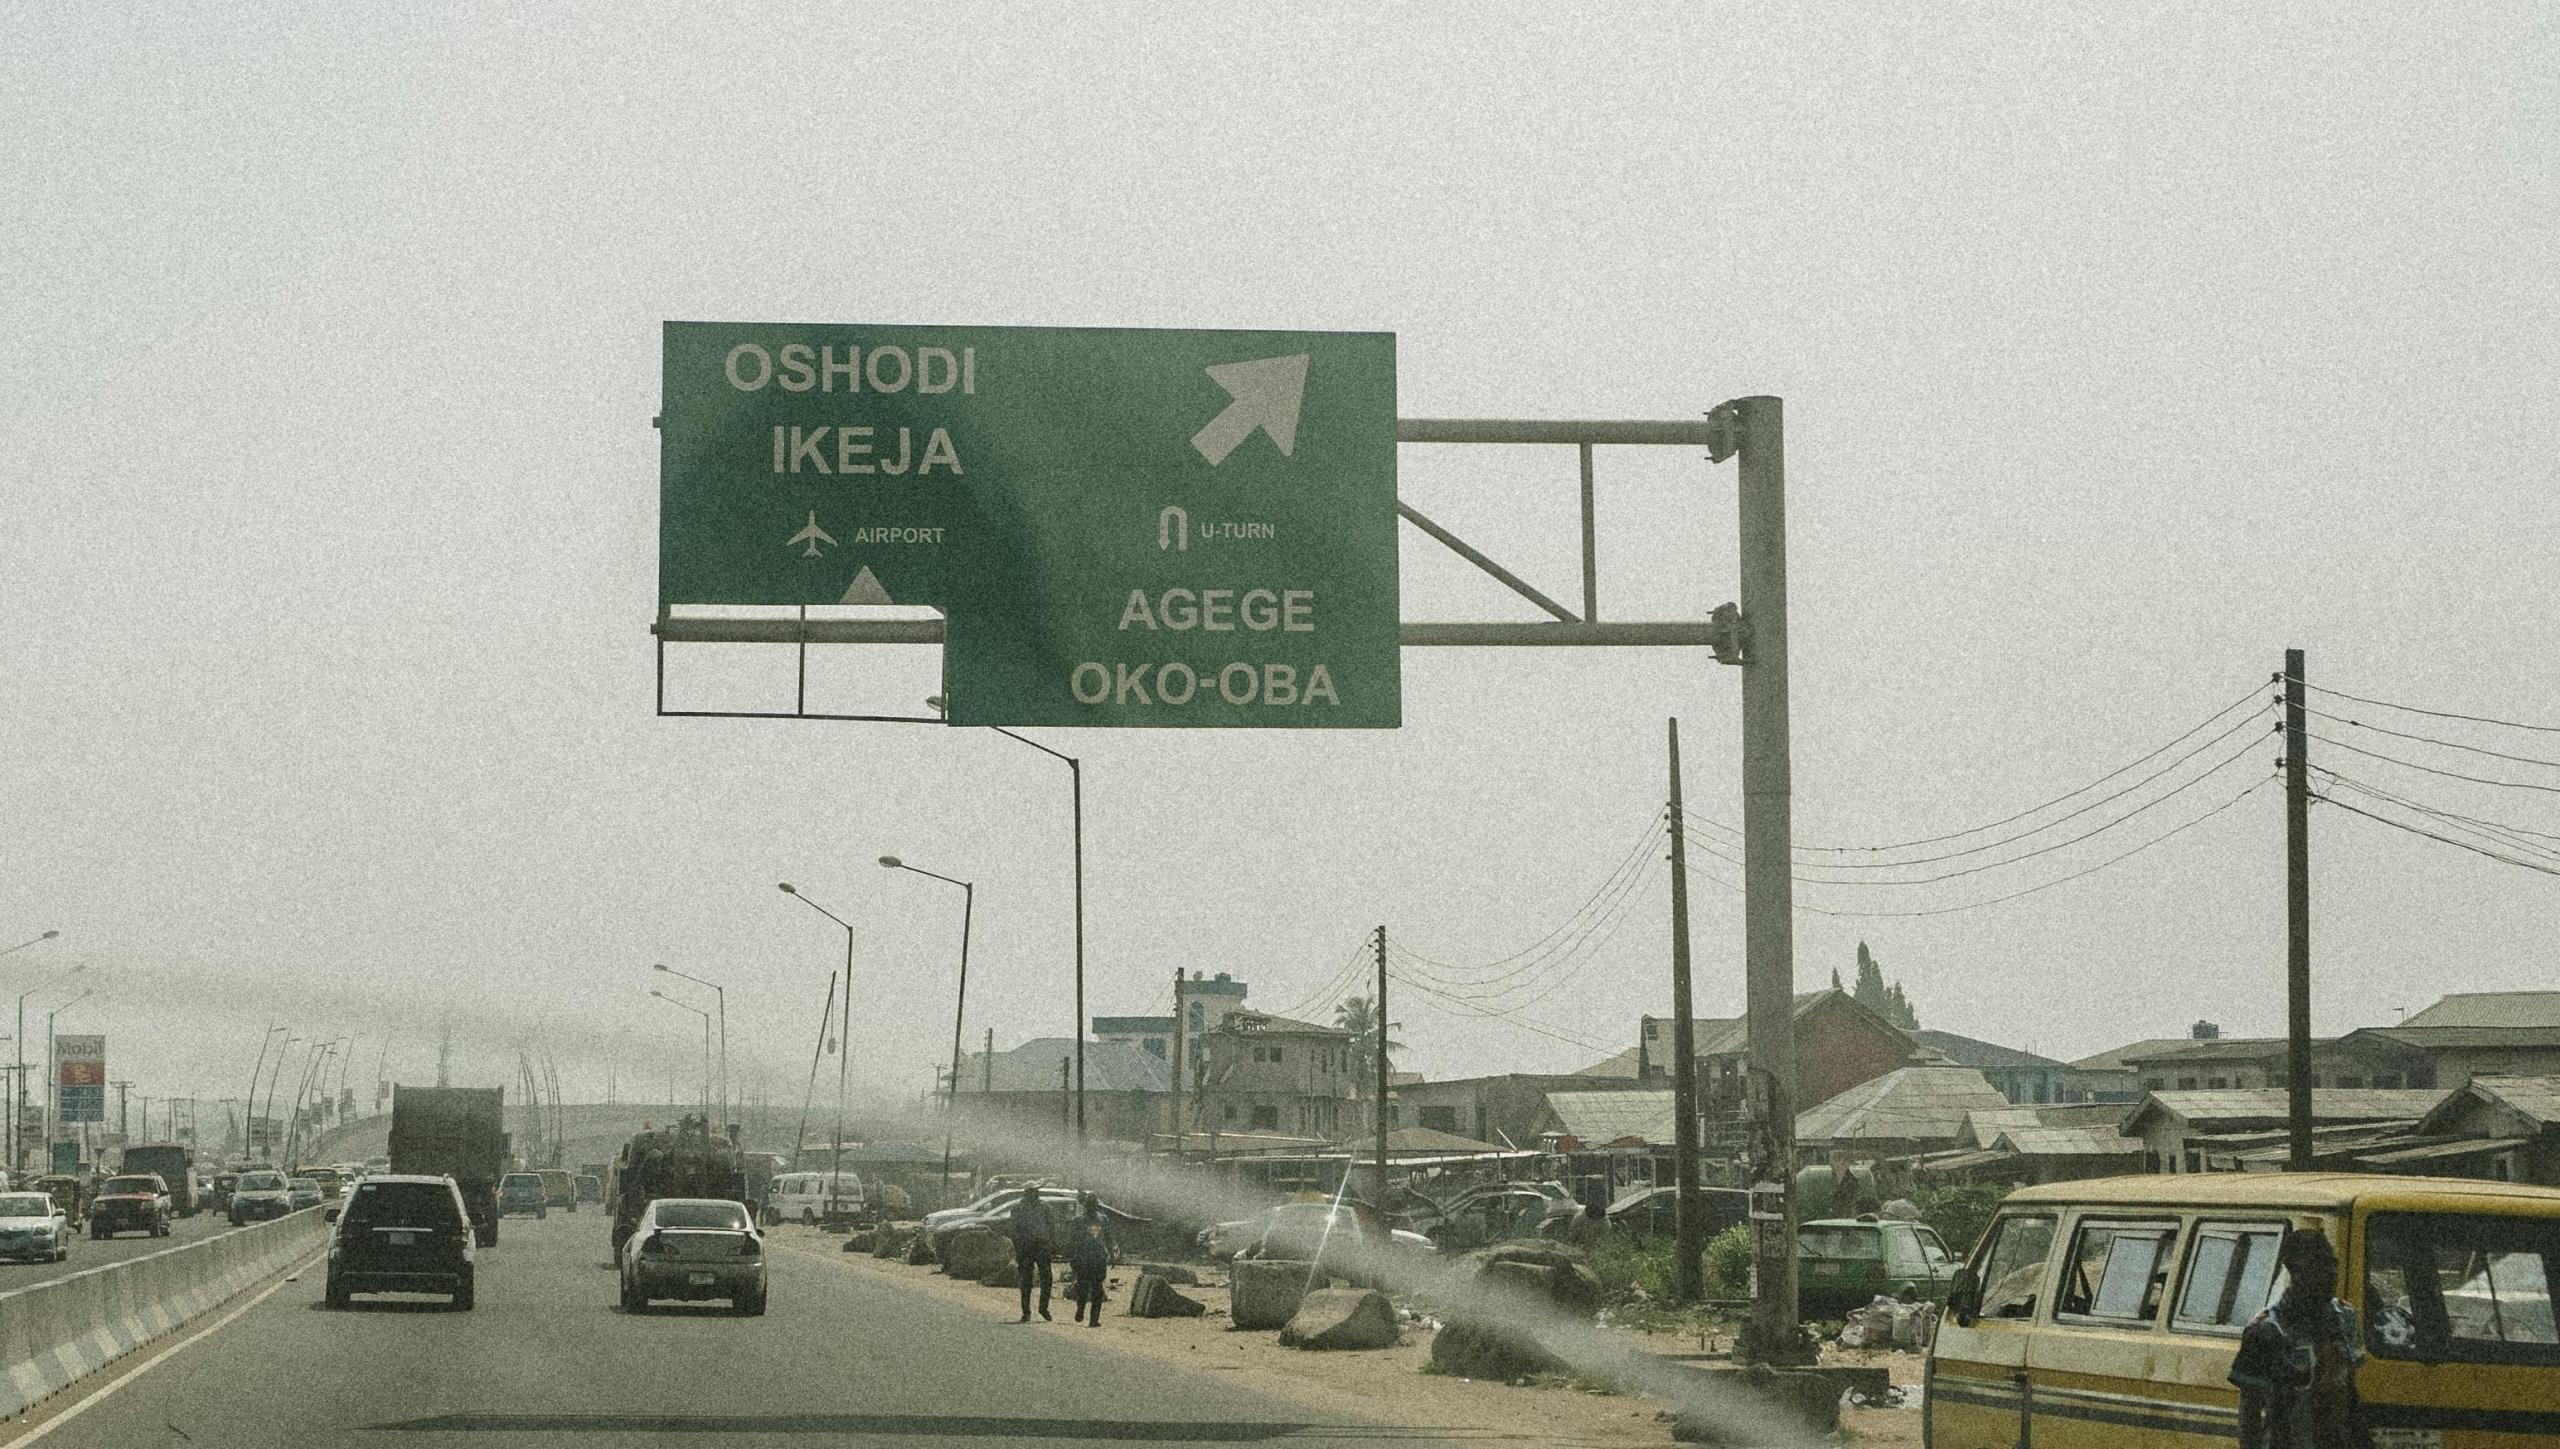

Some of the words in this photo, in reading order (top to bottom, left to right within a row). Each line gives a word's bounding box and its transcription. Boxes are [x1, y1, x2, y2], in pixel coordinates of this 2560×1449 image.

[724, 343, 976, 395] OSHODI
[773, 425, 964, 475] IKEJA
[855, 526, 945, 544] AIRPORT
[1200, 522, 1275, 540] U-TURN
[1118, 587, 1315, 632] AGEGE
[1071, 661, 1341, 706] OKO-OBA
